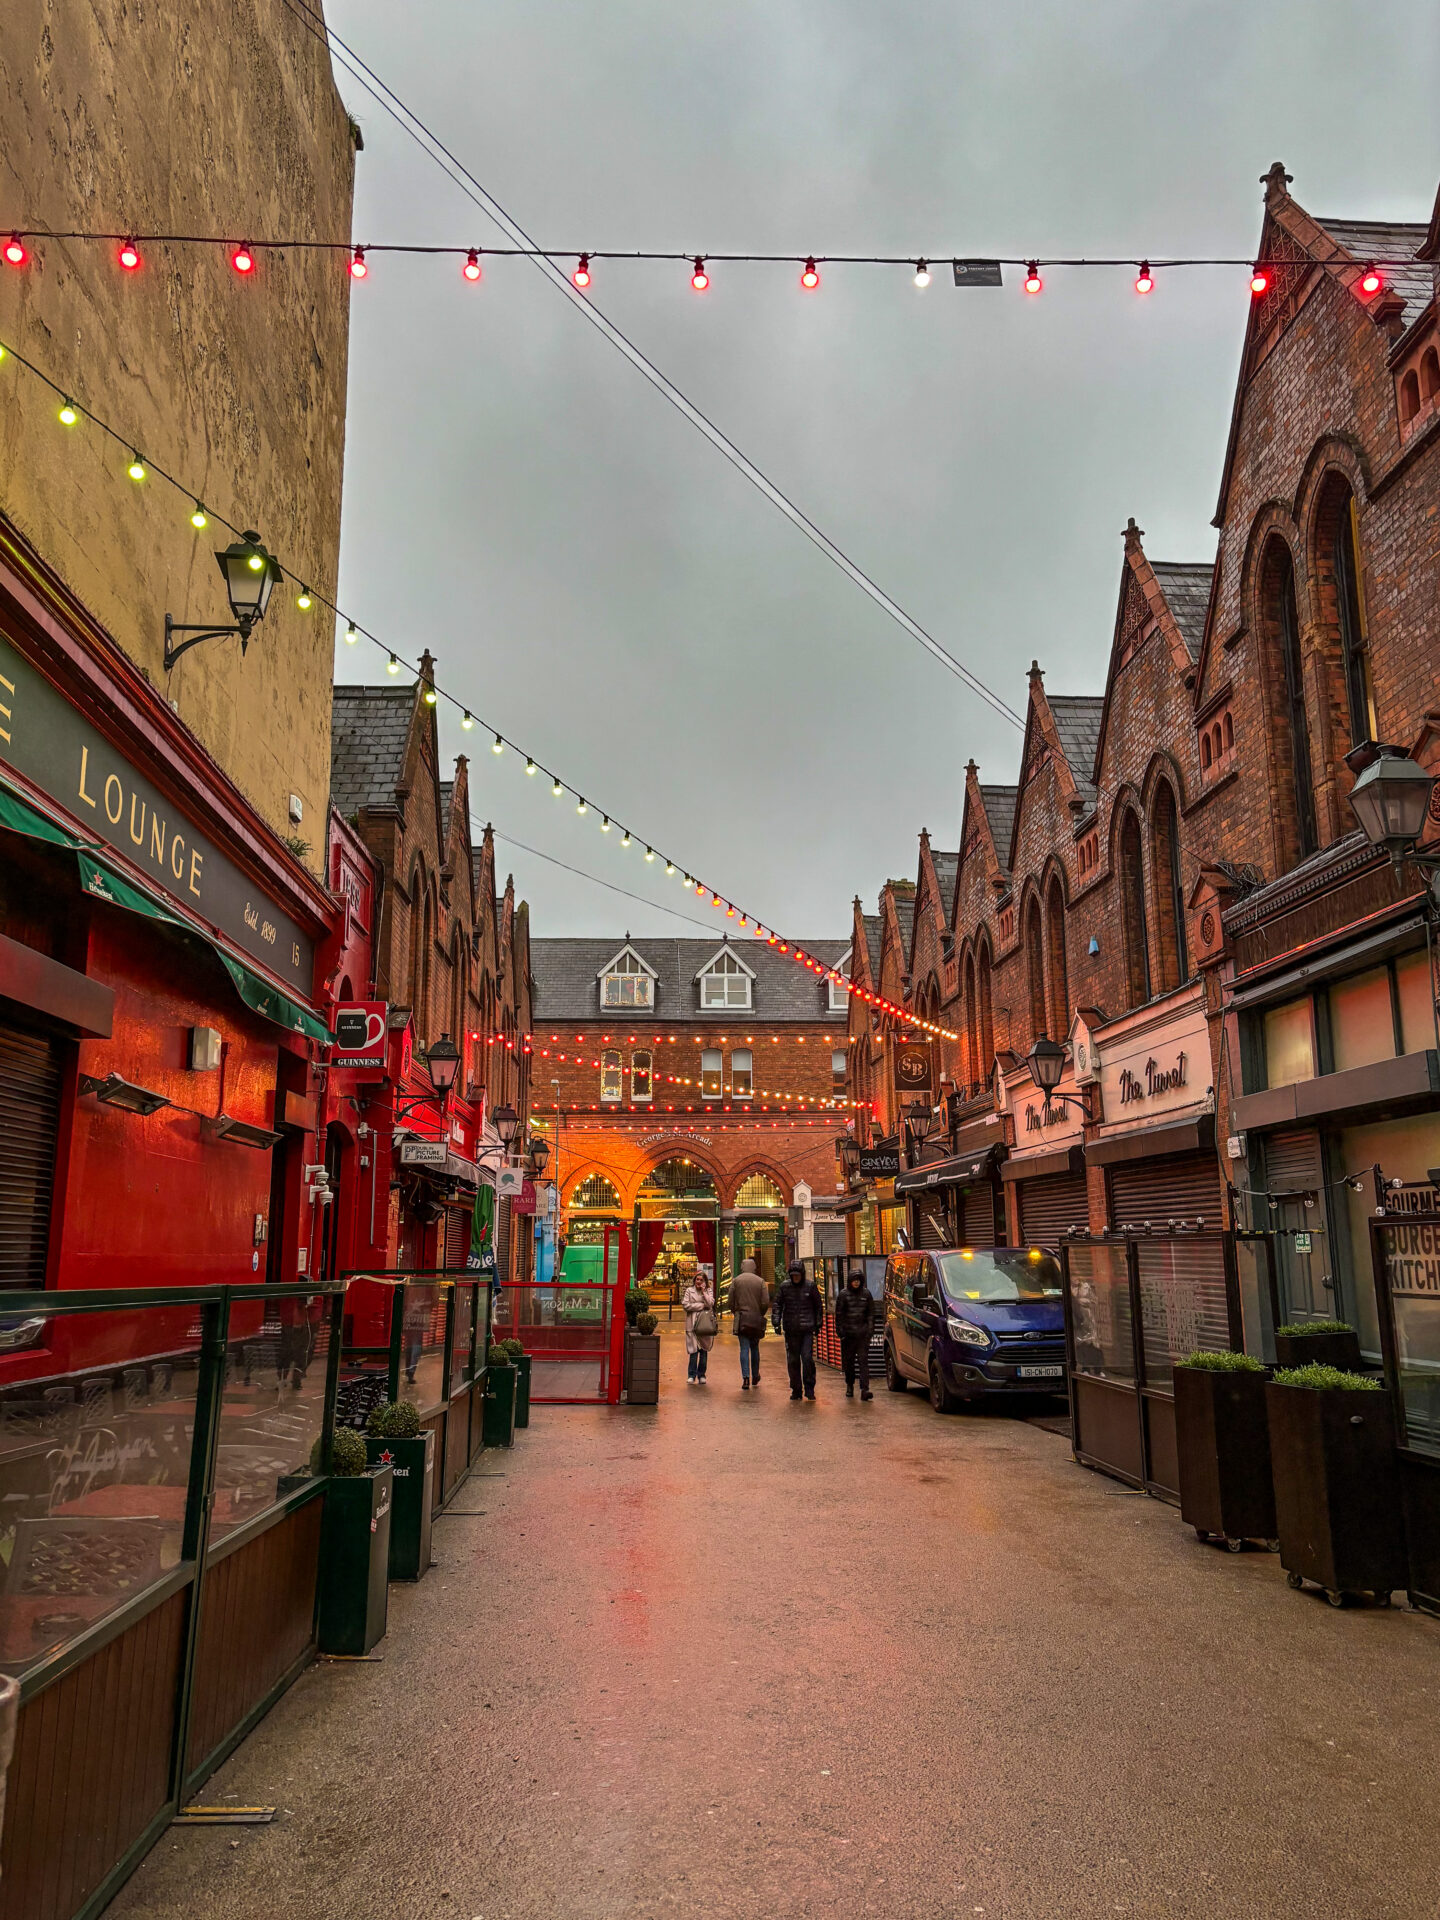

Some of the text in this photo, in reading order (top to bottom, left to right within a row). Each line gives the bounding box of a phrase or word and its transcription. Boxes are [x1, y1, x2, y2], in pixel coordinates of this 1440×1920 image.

[79, 745, 203, 897] LOUNGE
[292, 942, 300, 967] 15
[337, 1058, 380, 1066] GUINNESS
[1119, 1051, 1188, 1104] The Turret
[1025, 1098, 1067, 1131] The Turret
[685, 1131, 713, 1147] Arcade
[1025, 1367, 1058, 1377] 151-CN-1070
